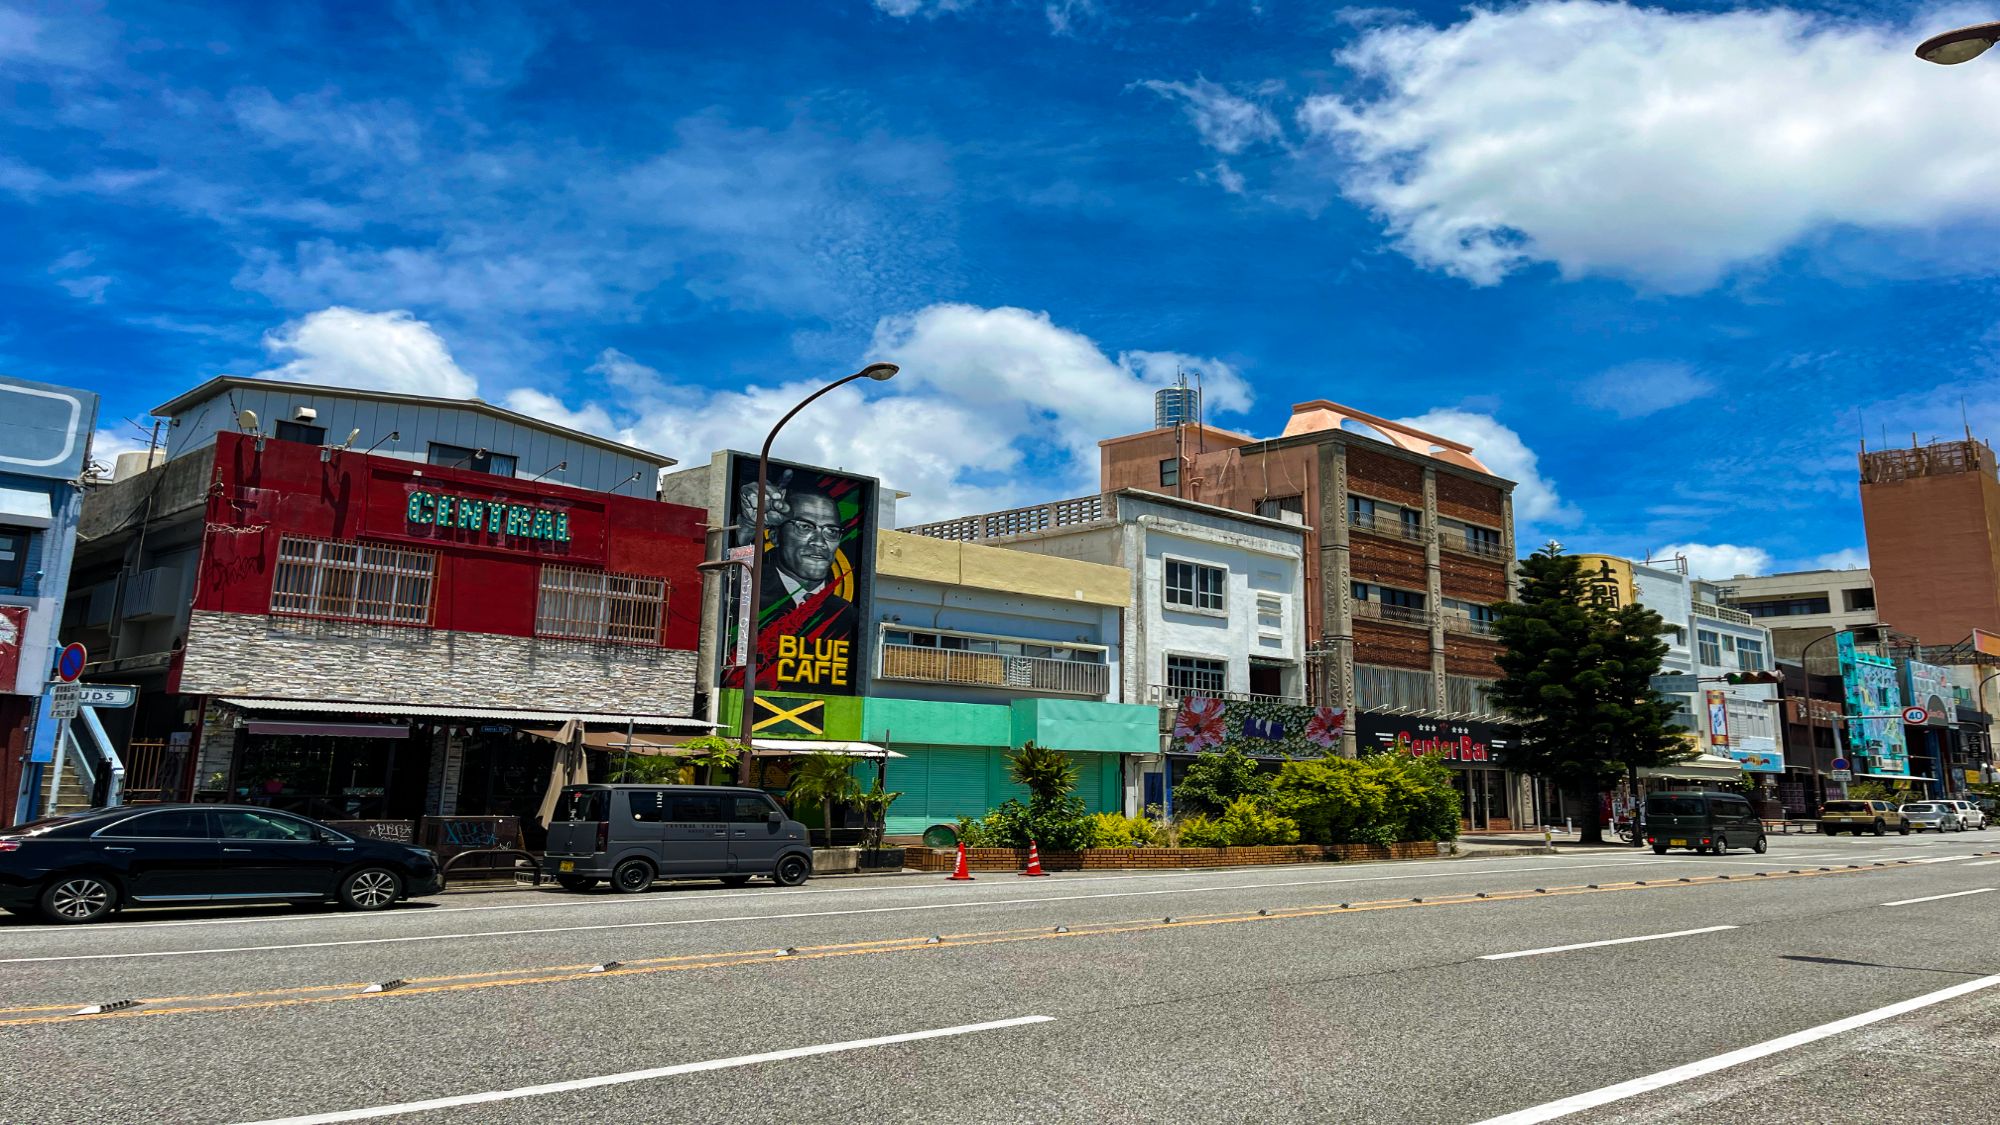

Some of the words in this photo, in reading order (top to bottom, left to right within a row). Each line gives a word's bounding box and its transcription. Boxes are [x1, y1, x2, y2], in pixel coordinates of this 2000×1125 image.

[408, 491, 571, 542] CENTRAL
[778, 634, 849, 663] BLUE
[777, 658, 848, 686] CAFE
[80, 691, 115, 701] UDS
[1908, 711, 1923, 720] 40
[1397, 731, 1459, 760] Center
[1460, 735, 1488, 762] Bar
